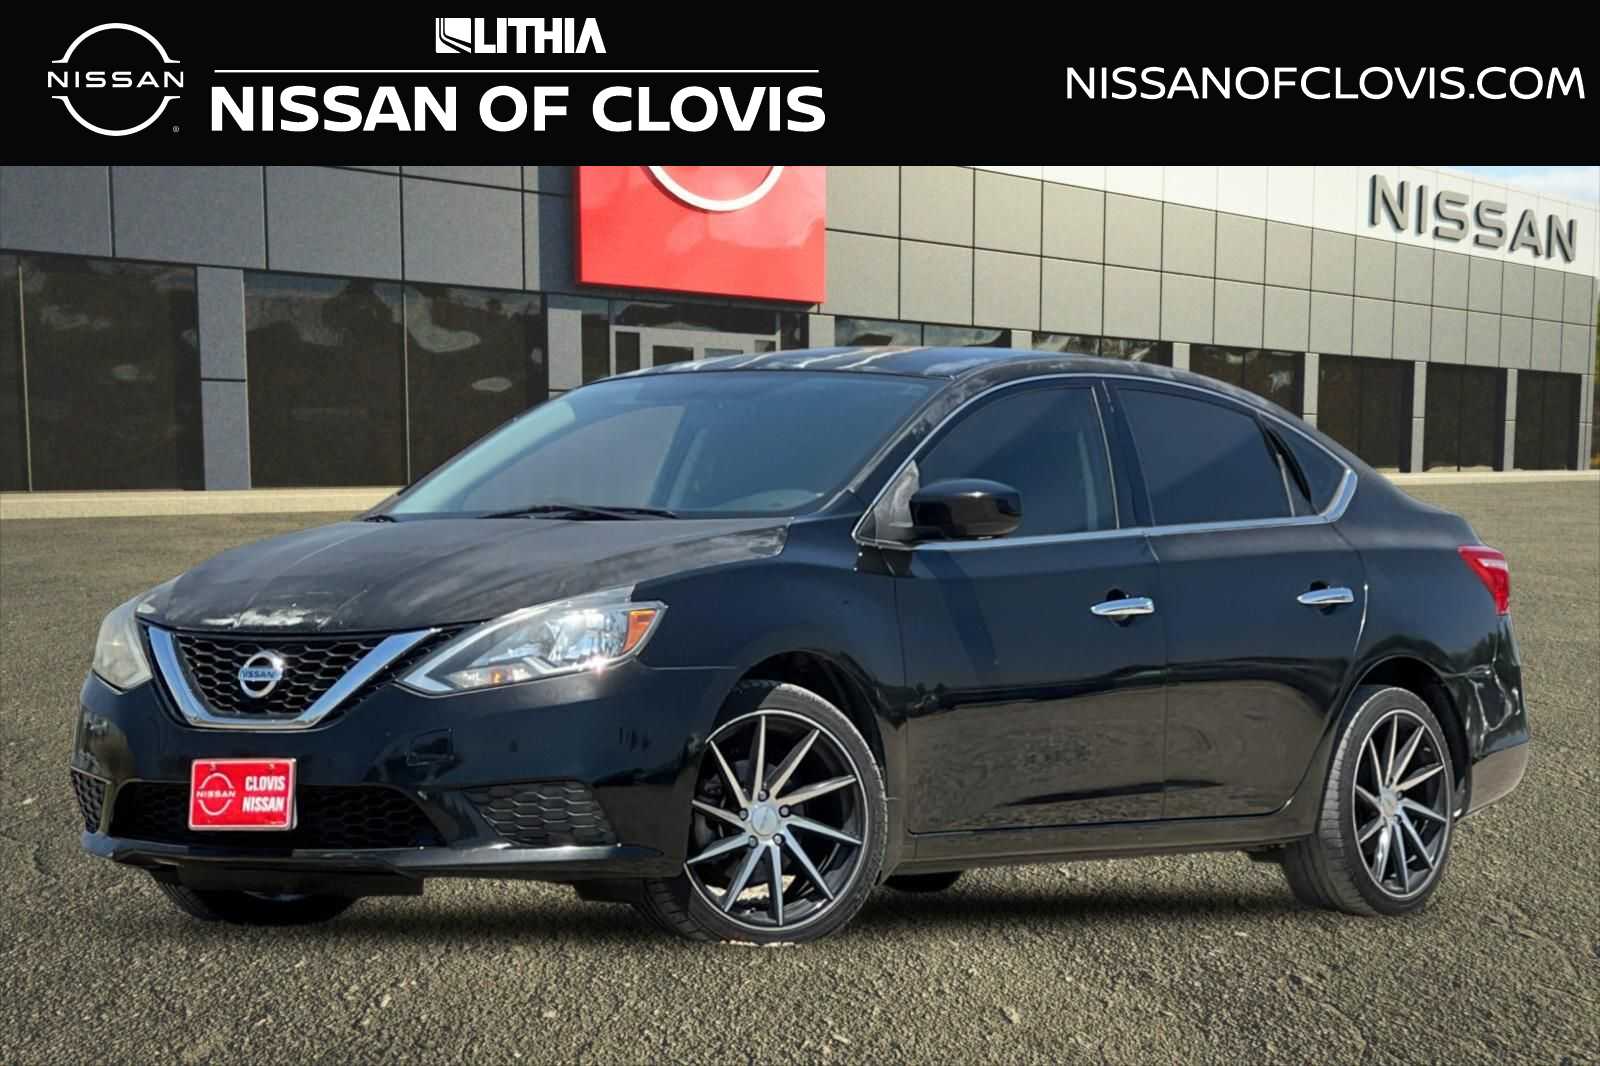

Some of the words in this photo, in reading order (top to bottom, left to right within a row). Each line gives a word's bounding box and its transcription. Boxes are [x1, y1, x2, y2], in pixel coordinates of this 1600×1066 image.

[1369, 173, 1578, 263] NISSAN
[245, 775, 285, 791] CLOVIS
[196, 790, 237, 798] NISSAN
[242, 796, 285, 812] NISSAN
